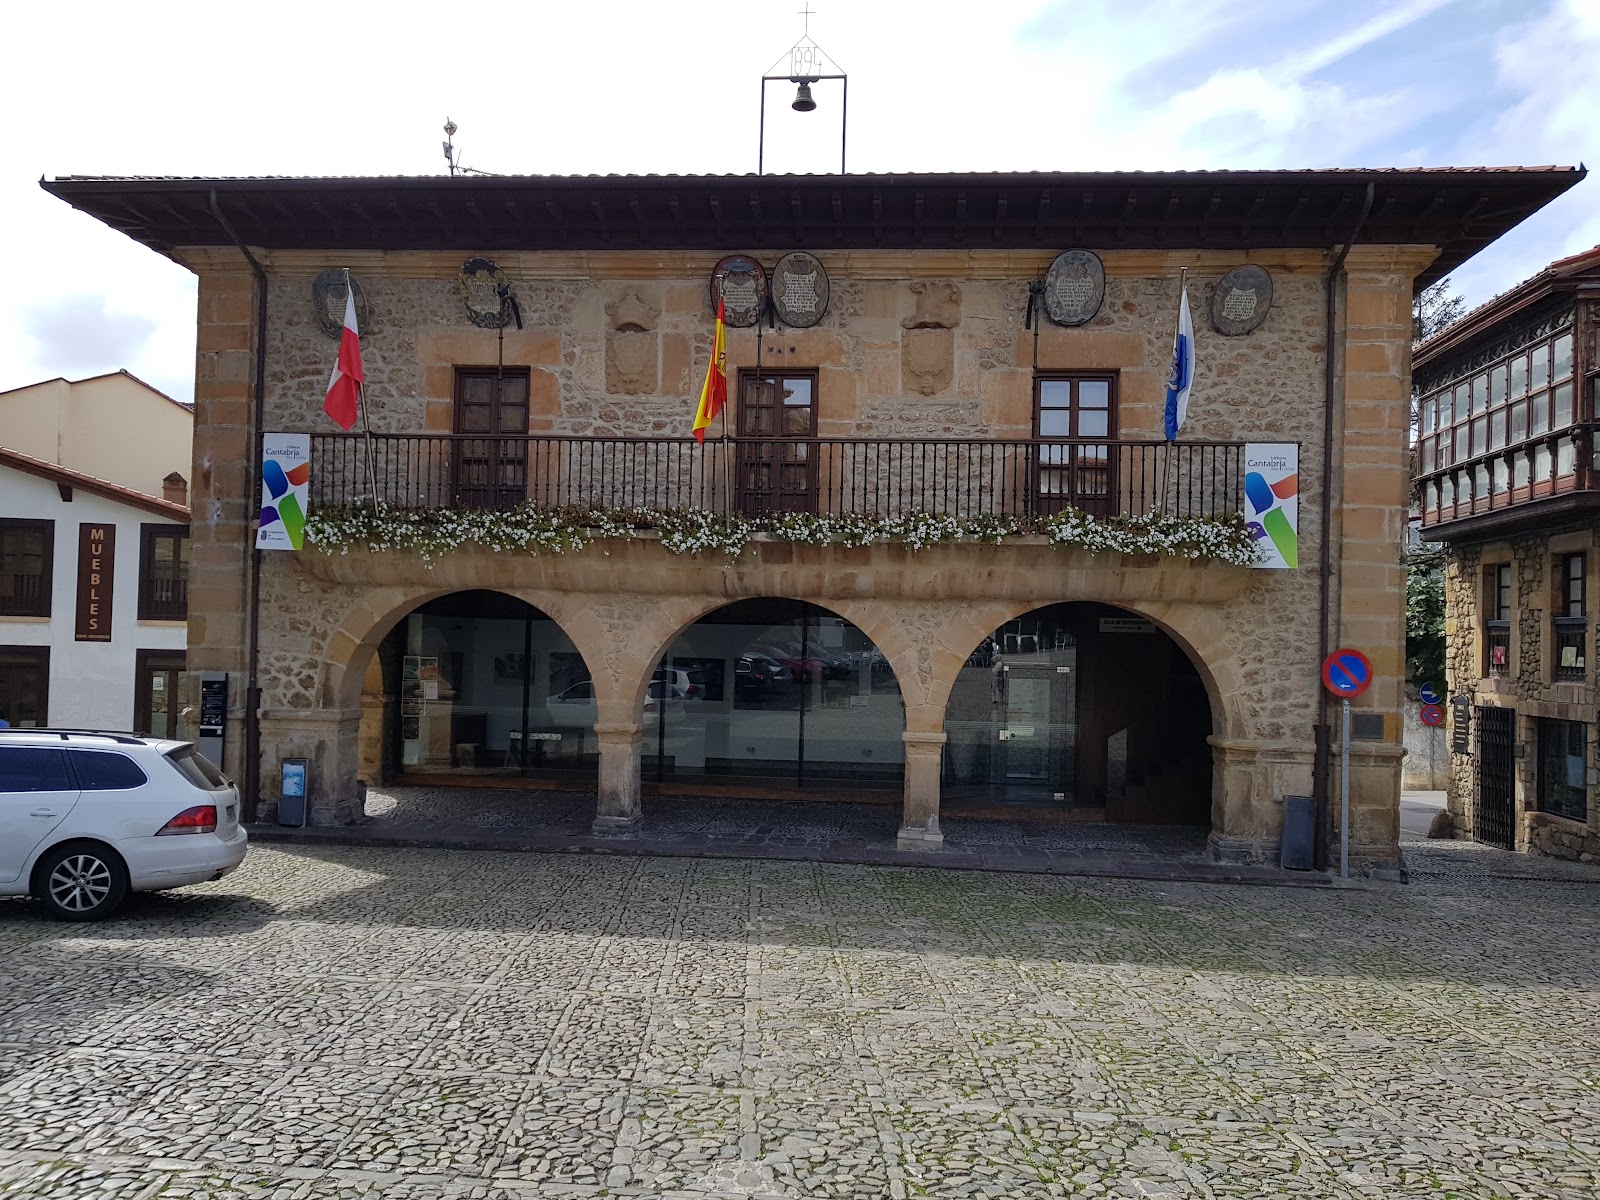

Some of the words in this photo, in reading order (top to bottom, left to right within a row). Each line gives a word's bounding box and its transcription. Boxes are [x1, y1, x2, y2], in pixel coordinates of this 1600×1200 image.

[789, 47, 822, 77] 1894
[1247, 459, 1287, 471] Cantabria
[88, 528, 104, 630] MUEBLES
